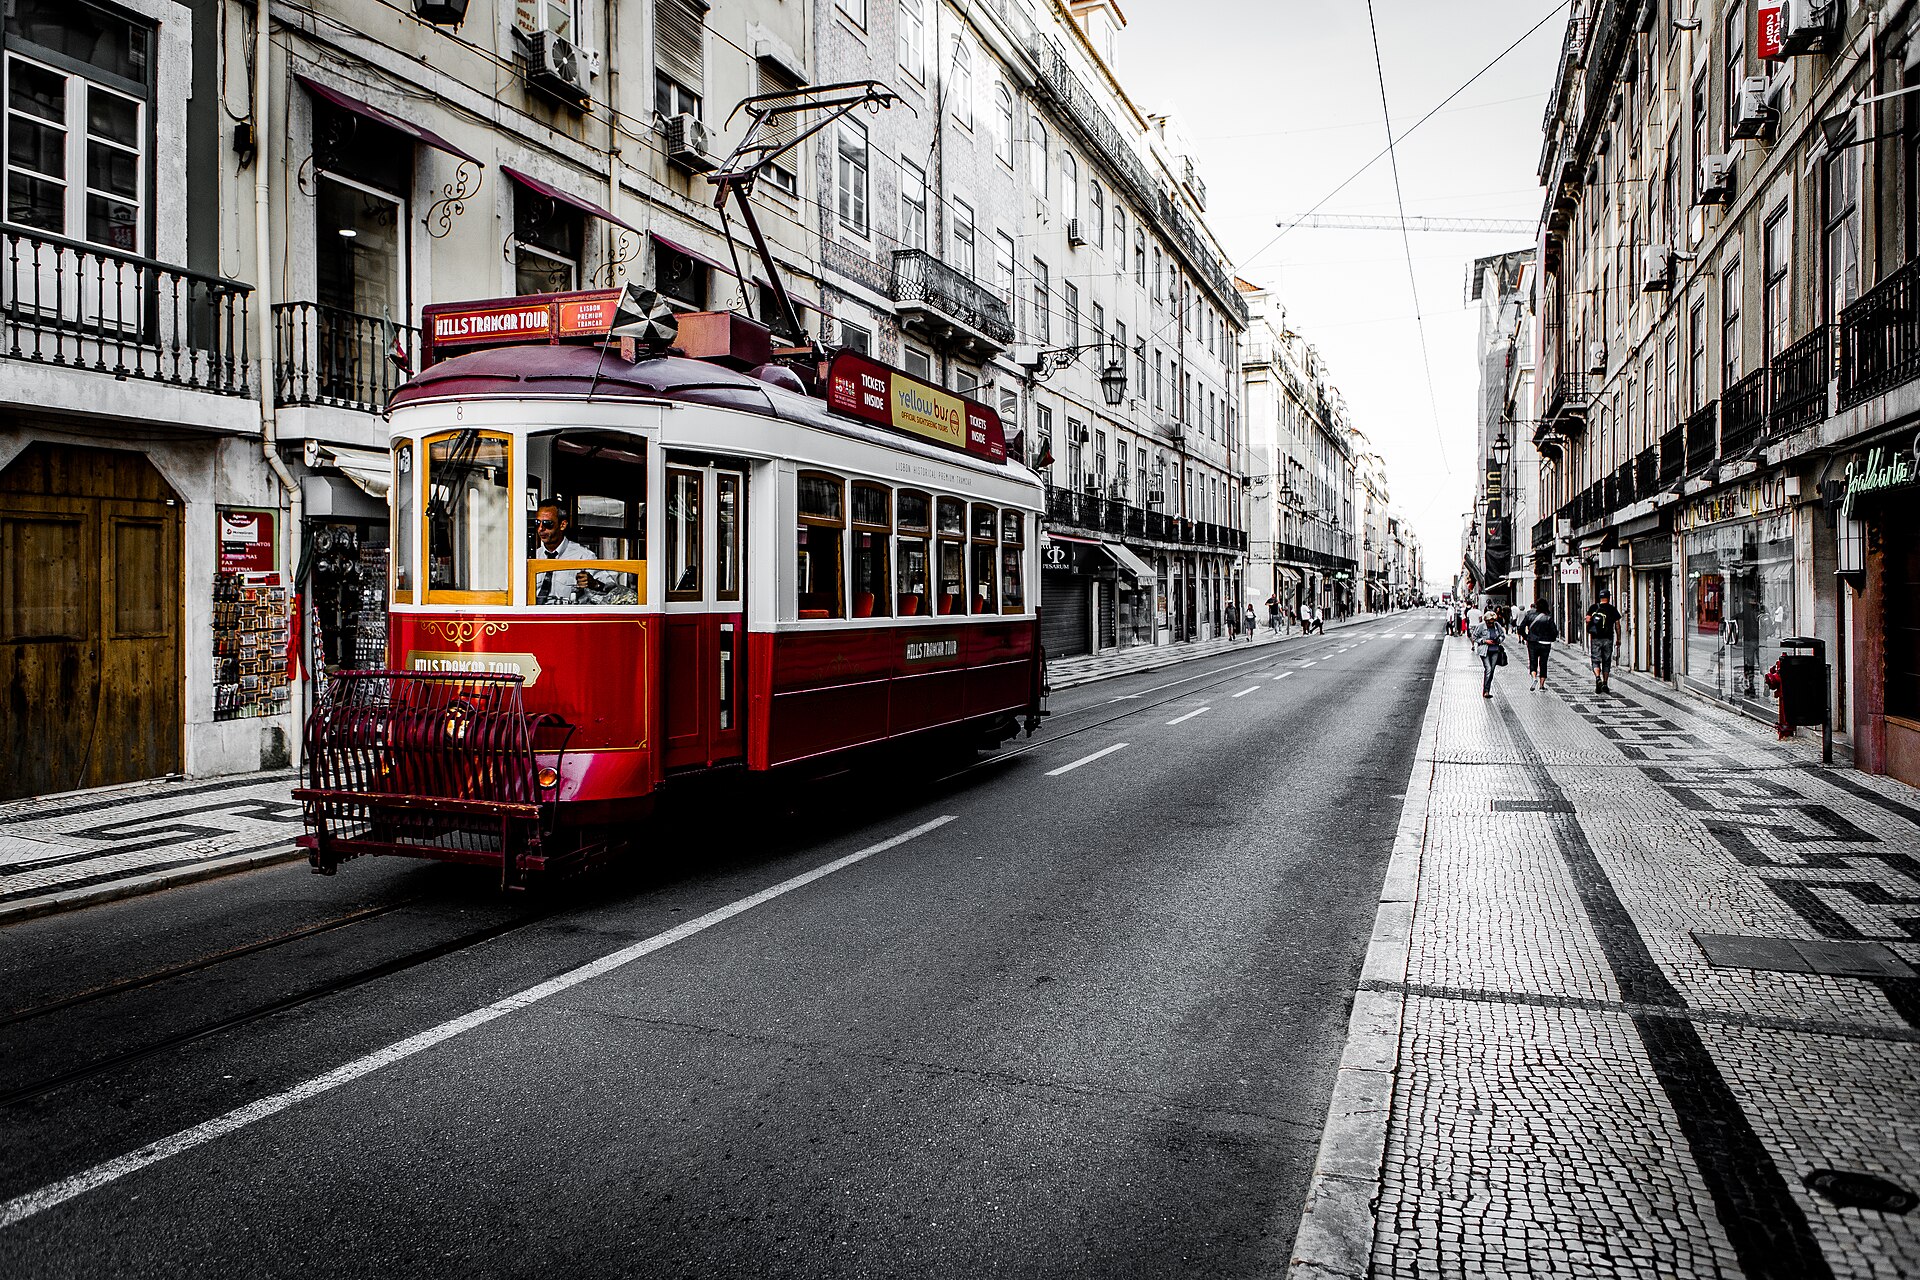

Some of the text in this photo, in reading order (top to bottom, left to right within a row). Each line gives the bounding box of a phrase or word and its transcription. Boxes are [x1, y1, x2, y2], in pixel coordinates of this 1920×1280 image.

[577, 312, 603, 320] PREMIUM
[579, 304, 601, 312] LISBON
[436, 311, 549, 336] HILLS TRAMCAR TOUR
[577, 320, 603, 328] TRAMCAR
[861, 374, 885, 393] TICKETS
[864, 392, 884, 410] INSIDE
[934, 398, 948, 422] bus
[457, 406, 463, 420] 8
[901, 411, 948, 433] OFFICIAL SIGHTSEEING TOURS
[970, 415, 986, 430] TICKETS
[972, 430, 986, 444] INSIDE
[896, 462, 911, 472] LISBON
[938, 472, 954, 482] PREMIUM
[906, 640, 957, 660] HILLS TRAMCAR TOUR
